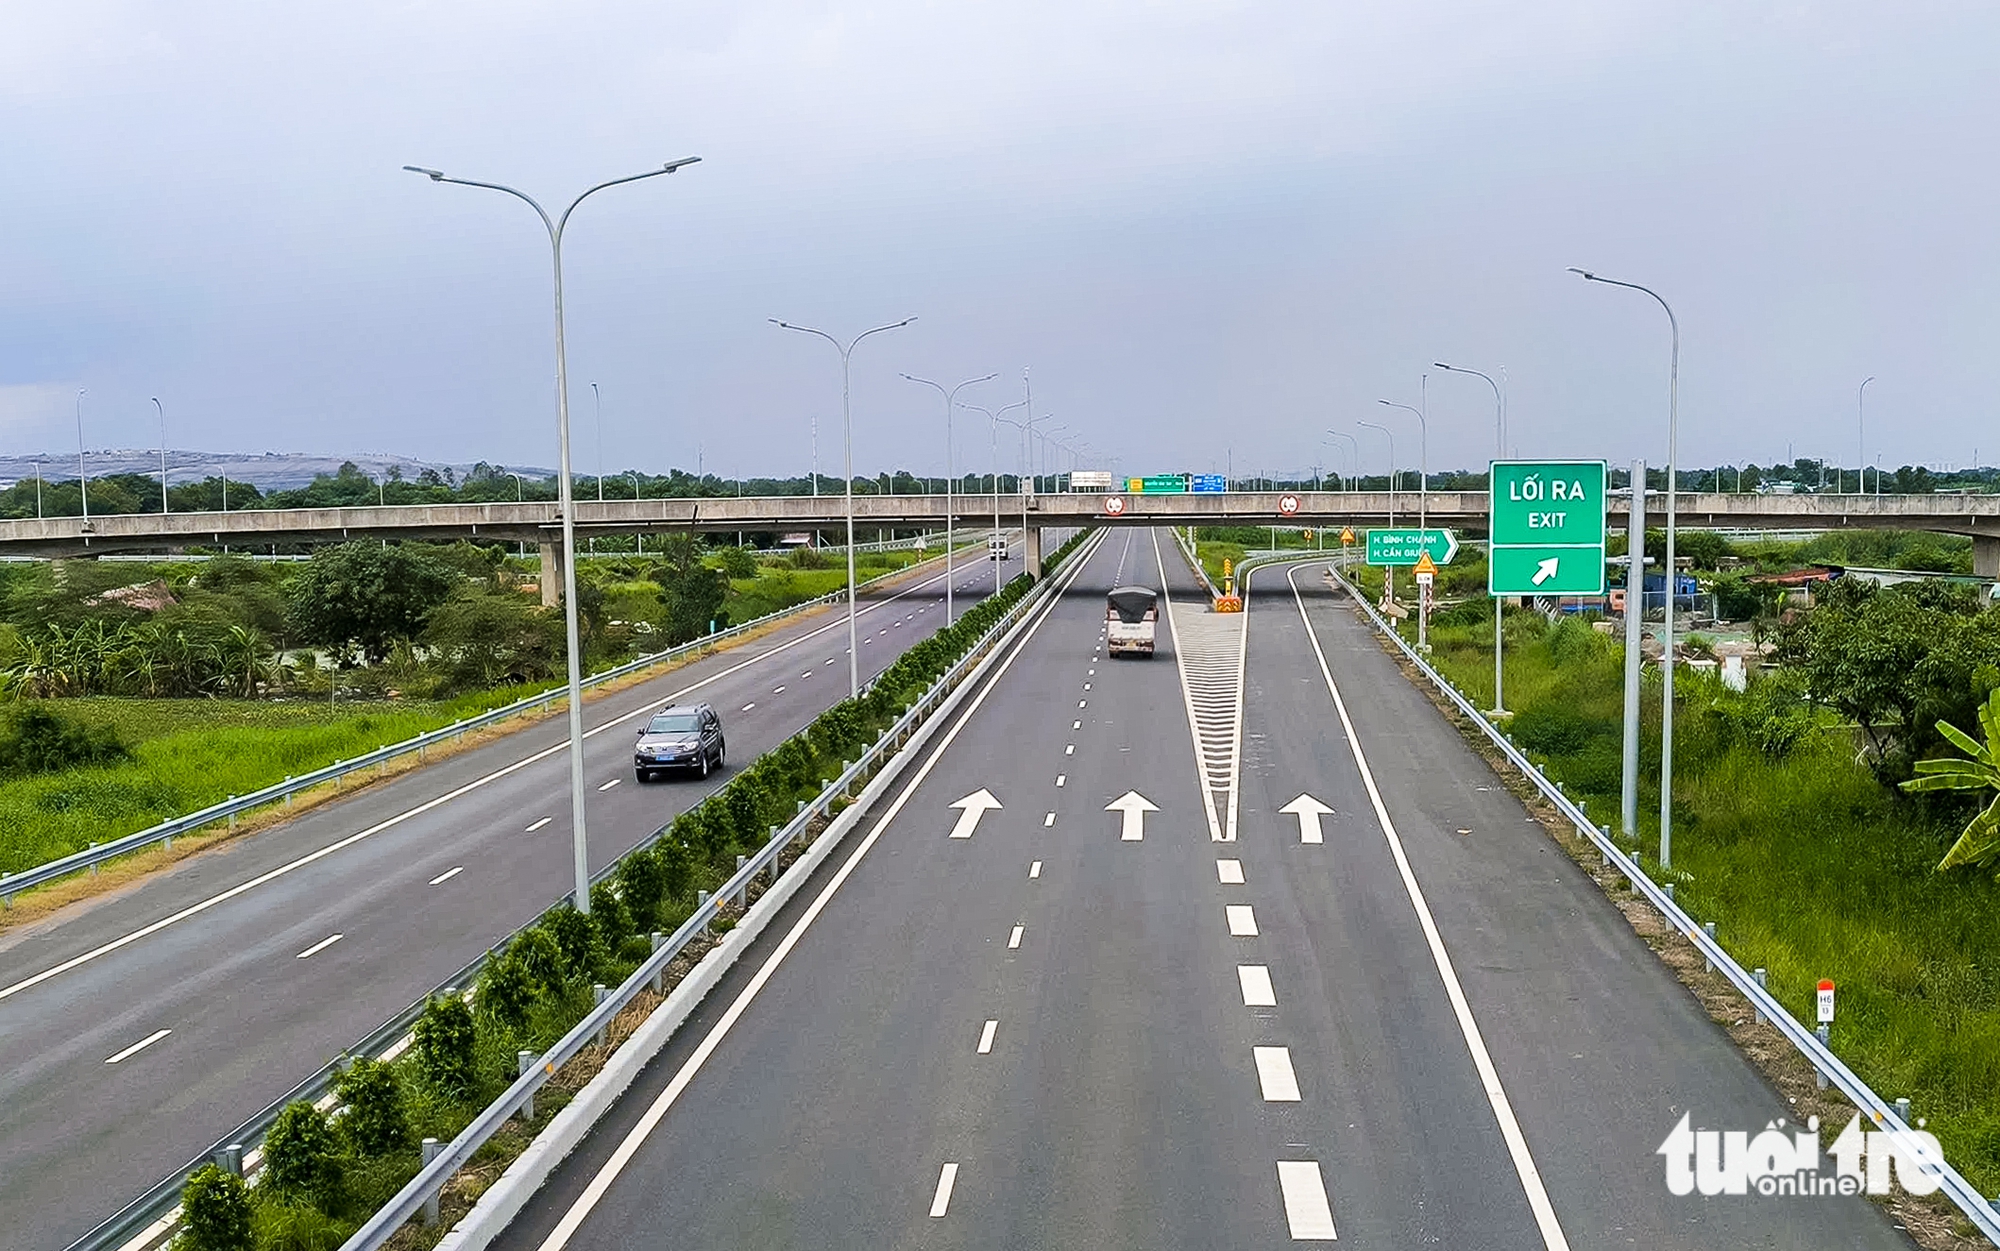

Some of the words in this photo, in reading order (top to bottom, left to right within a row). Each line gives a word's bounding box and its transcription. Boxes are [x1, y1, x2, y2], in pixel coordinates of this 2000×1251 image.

[1510, 473, 1544, 501] LỐI
[1552, 480, 1585, 501] RA
[1528, 512, 1566, 528] EXIT
[1819, 995, 1832, 1004] H6
